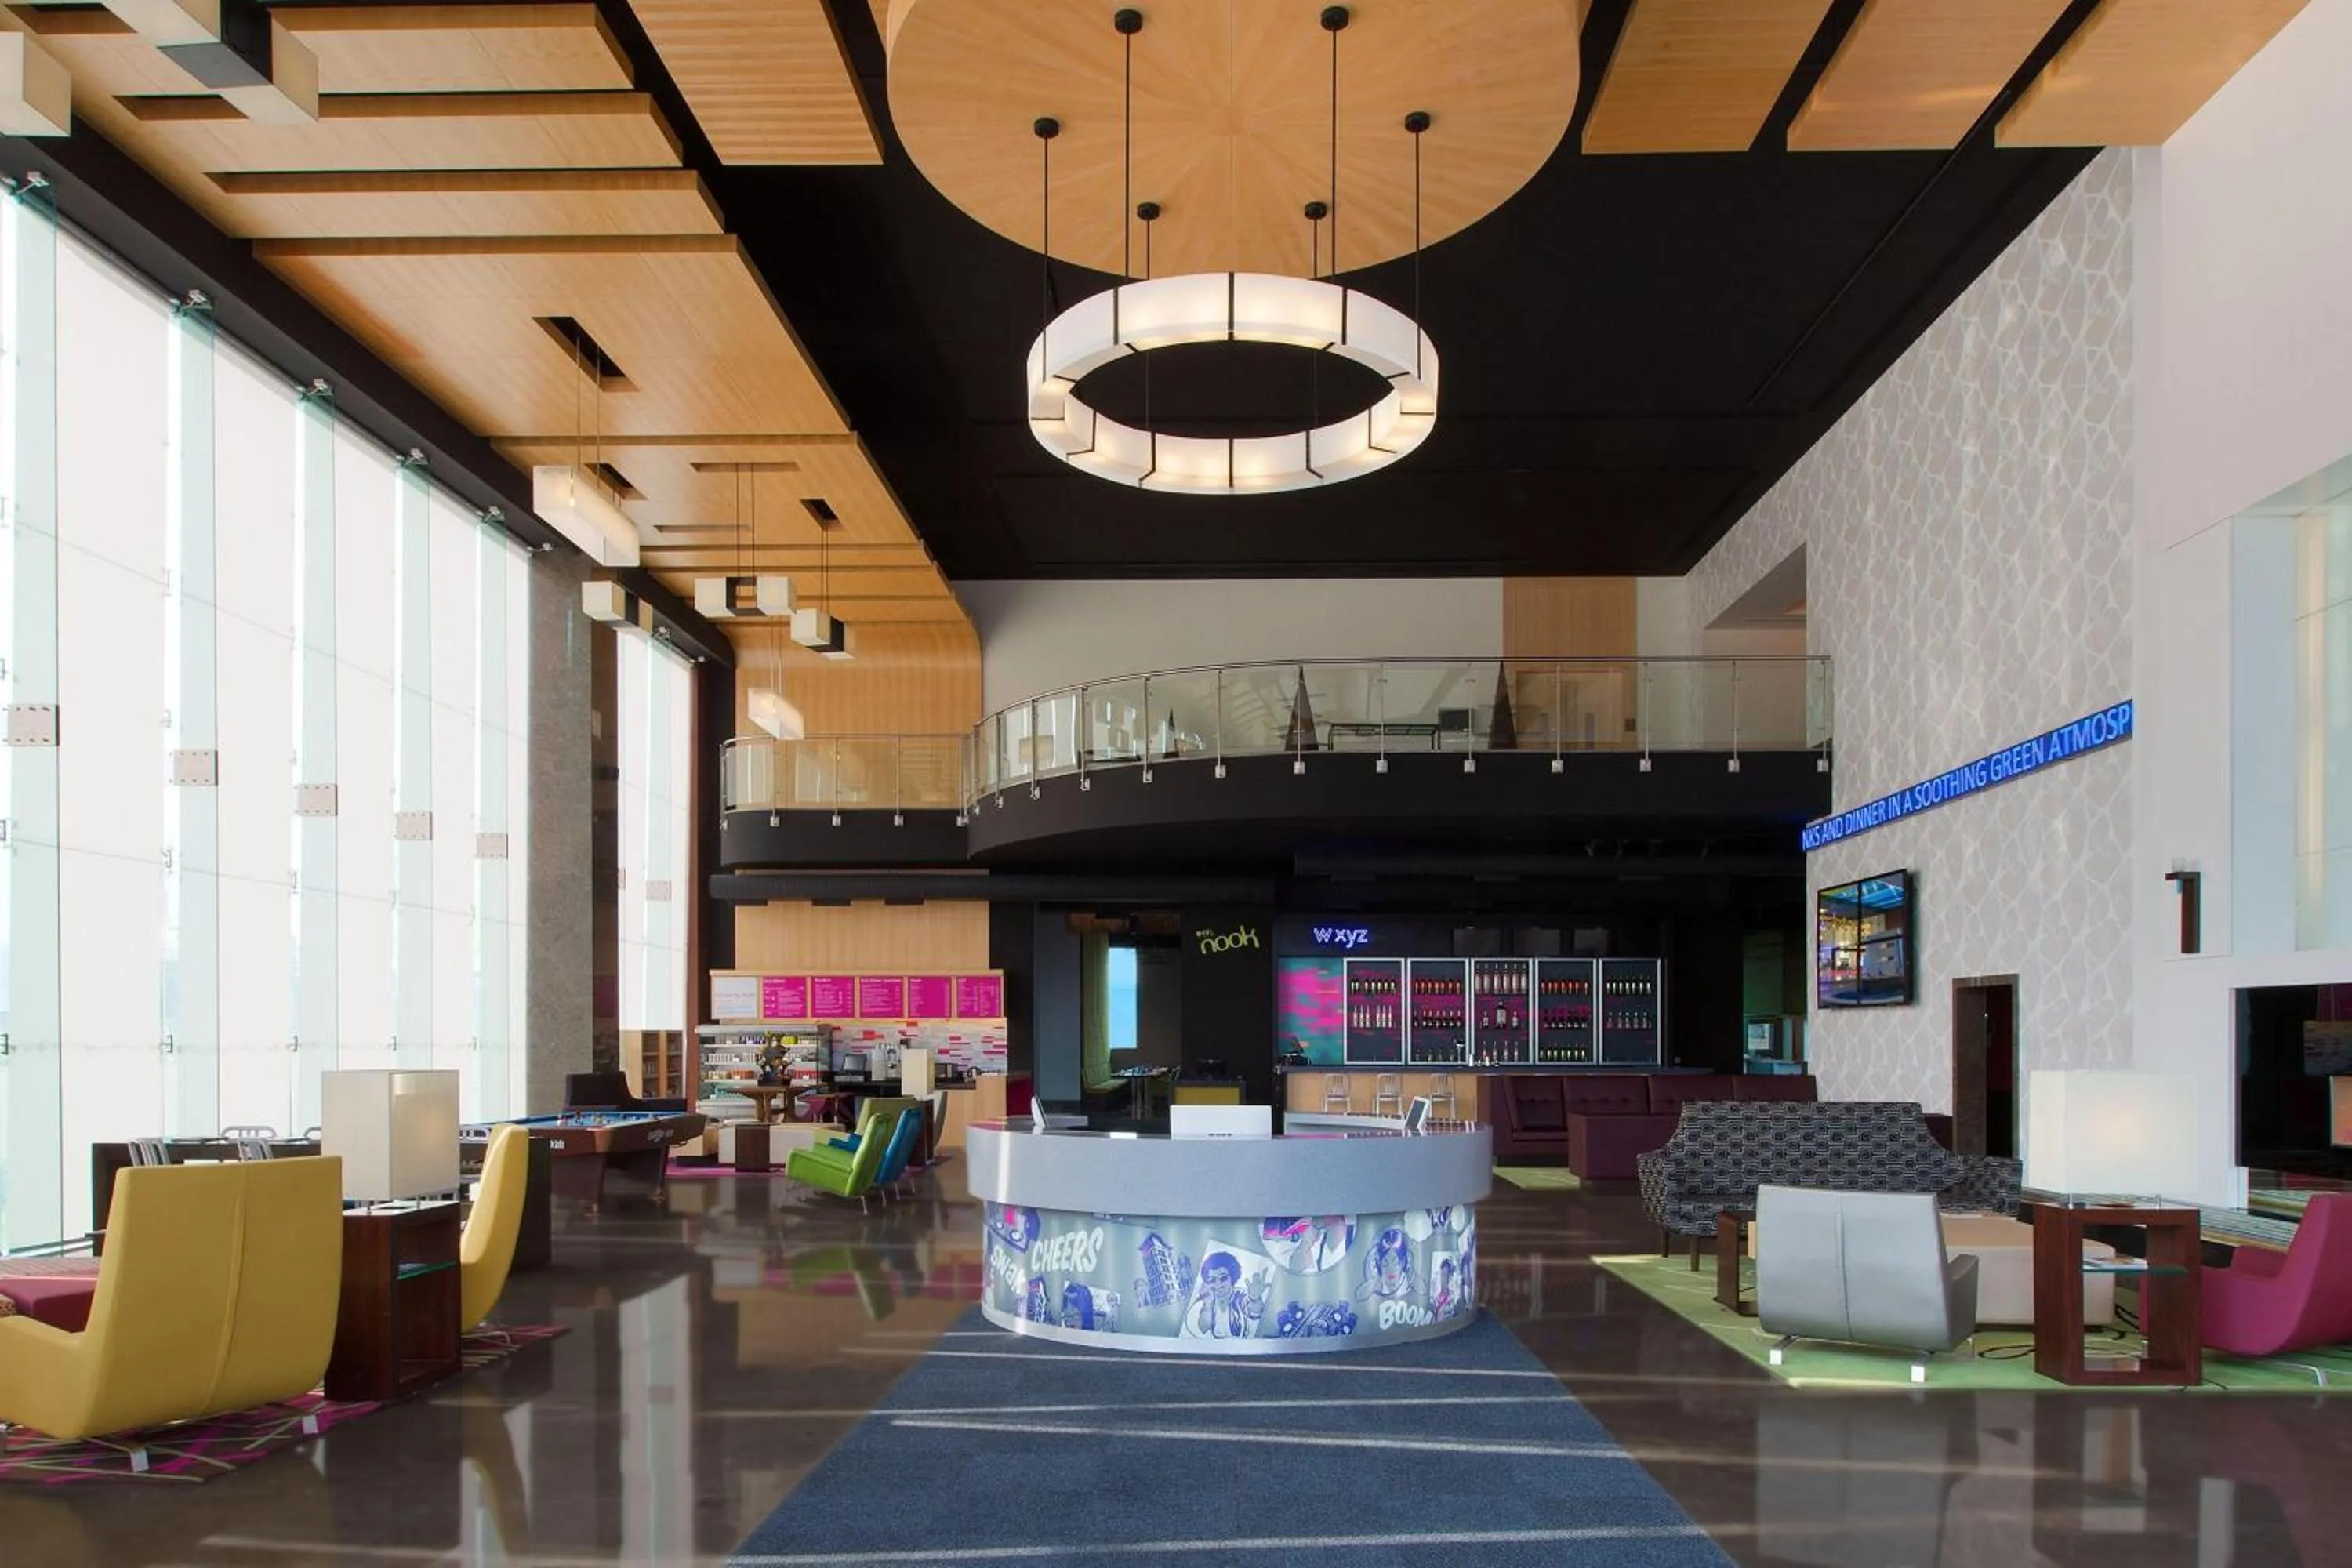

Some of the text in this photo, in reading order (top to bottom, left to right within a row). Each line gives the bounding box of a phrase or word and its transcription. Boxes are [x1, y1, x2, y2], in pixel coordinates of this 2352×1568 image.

[1821, 818, 1843, 844] AND
[1845, 800, 1886, 835] DINNER
[1889, 794, 1901, 819] IN
[1904, 789, 1913, 813] A
[1915, 760, 1987, 810] SOOTHING
[1990, 737, 2044, 781] GREEN
[2048, 703, 2134, 761] ATMOSP
[1200, 924, 1260, 954] nook
[1031, 1226, 1104, 1272] CHEERS
[1379, 1299, 1433, 1330] BOOM
